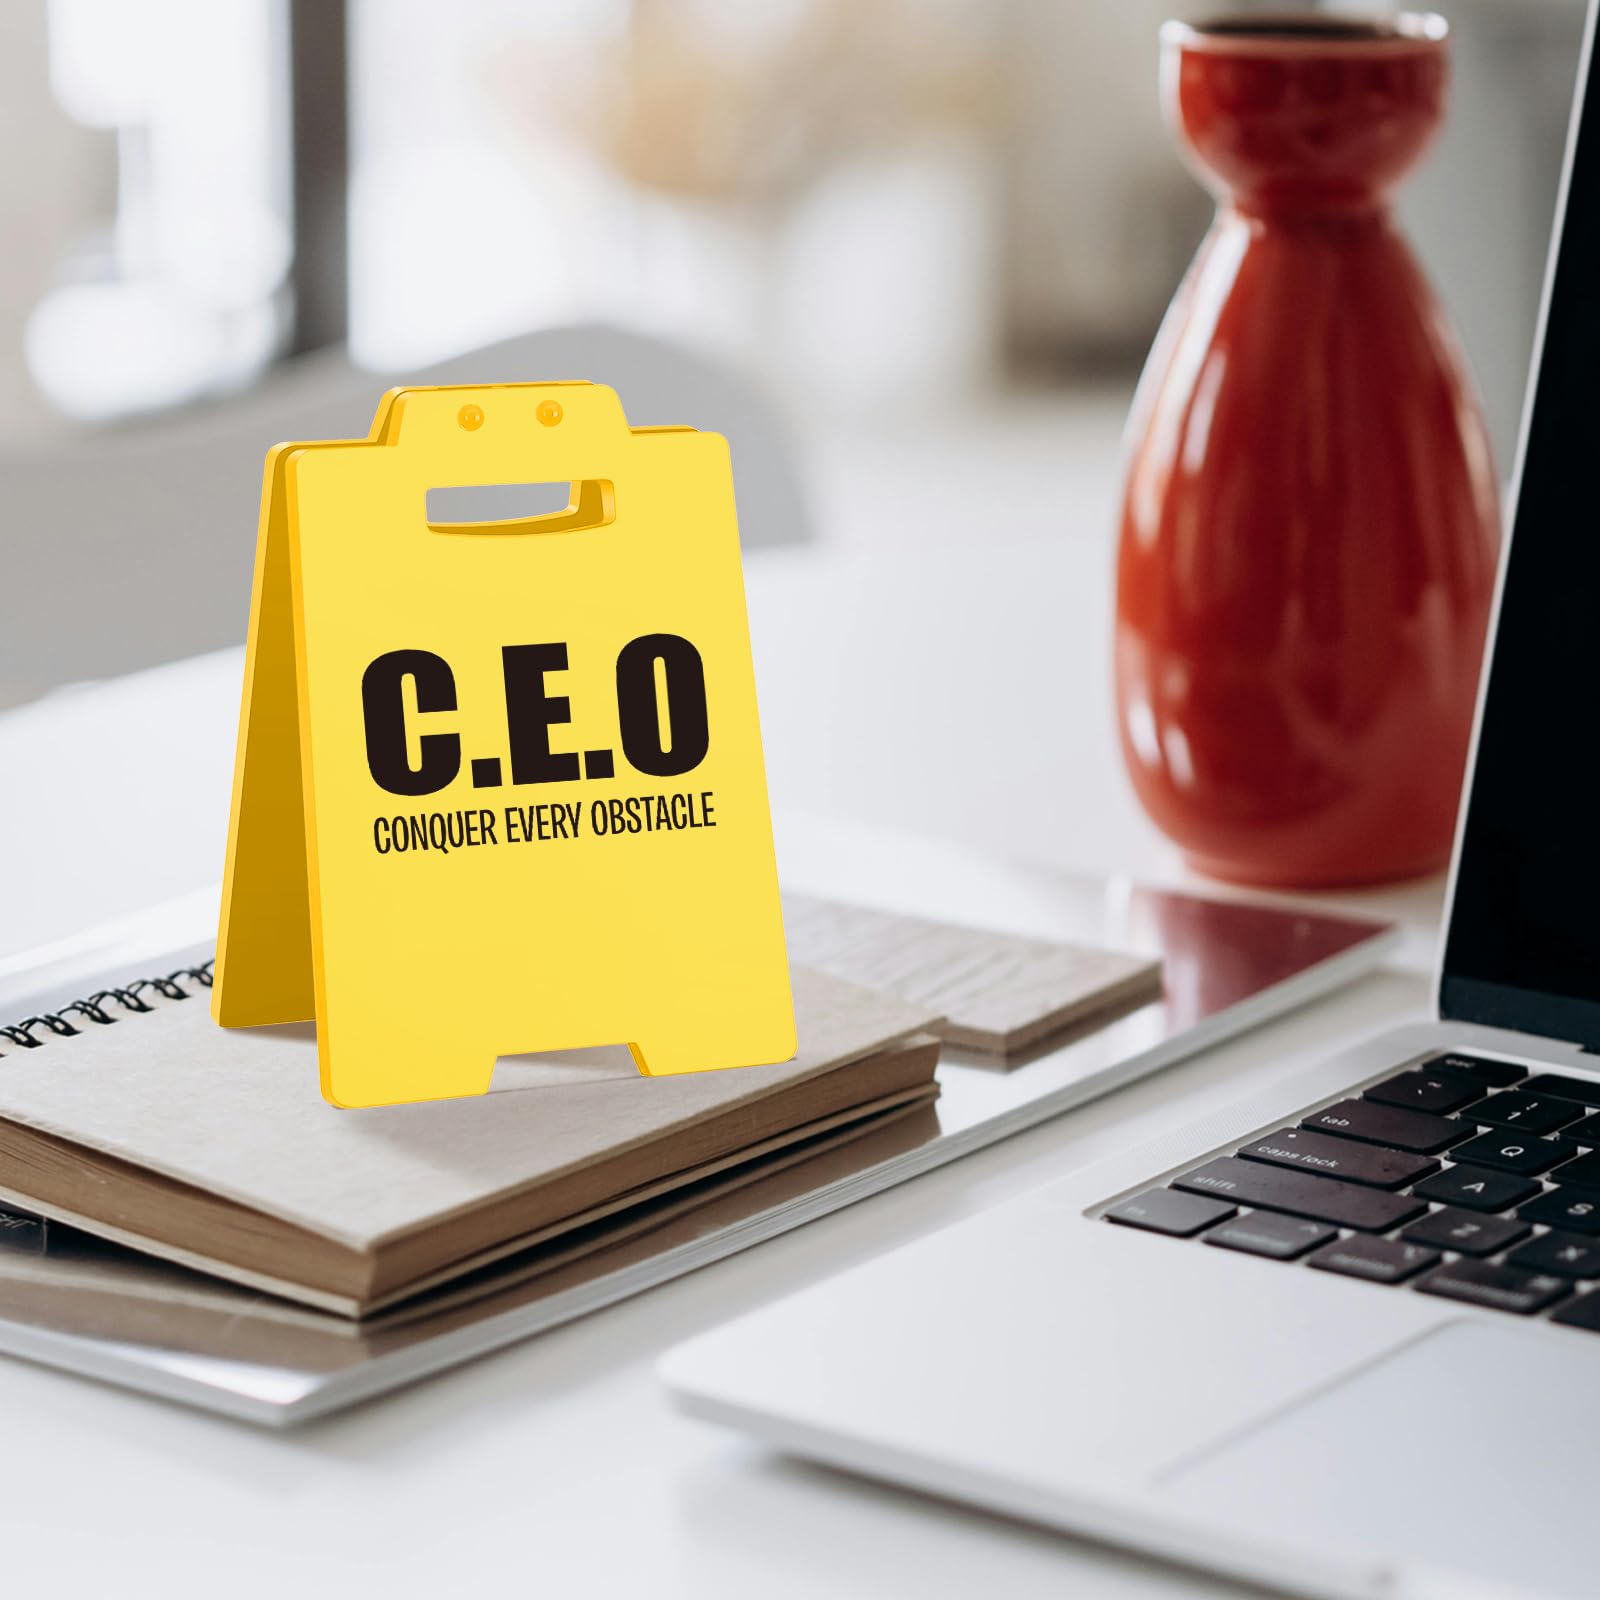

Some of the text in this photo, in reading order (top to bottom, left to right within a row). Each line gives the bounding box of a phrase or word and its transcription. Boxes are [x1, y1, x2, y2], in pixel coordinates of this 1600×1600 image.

[362, 634, 709, 796] C.E.O
[374, 792, 716, 854] CONQUER EVERY OBSTACLE
[1321, 1114, 1350, 1127] tab
[1257, 1144, 1340, 1168] caps lock
[1500, 1145, 1525, 1158] Q
[1192, 1174, 1237, 1190] shift
[1461, 1181, 1486, 1194] A
[1567, 1202, 1595, 1216] S
